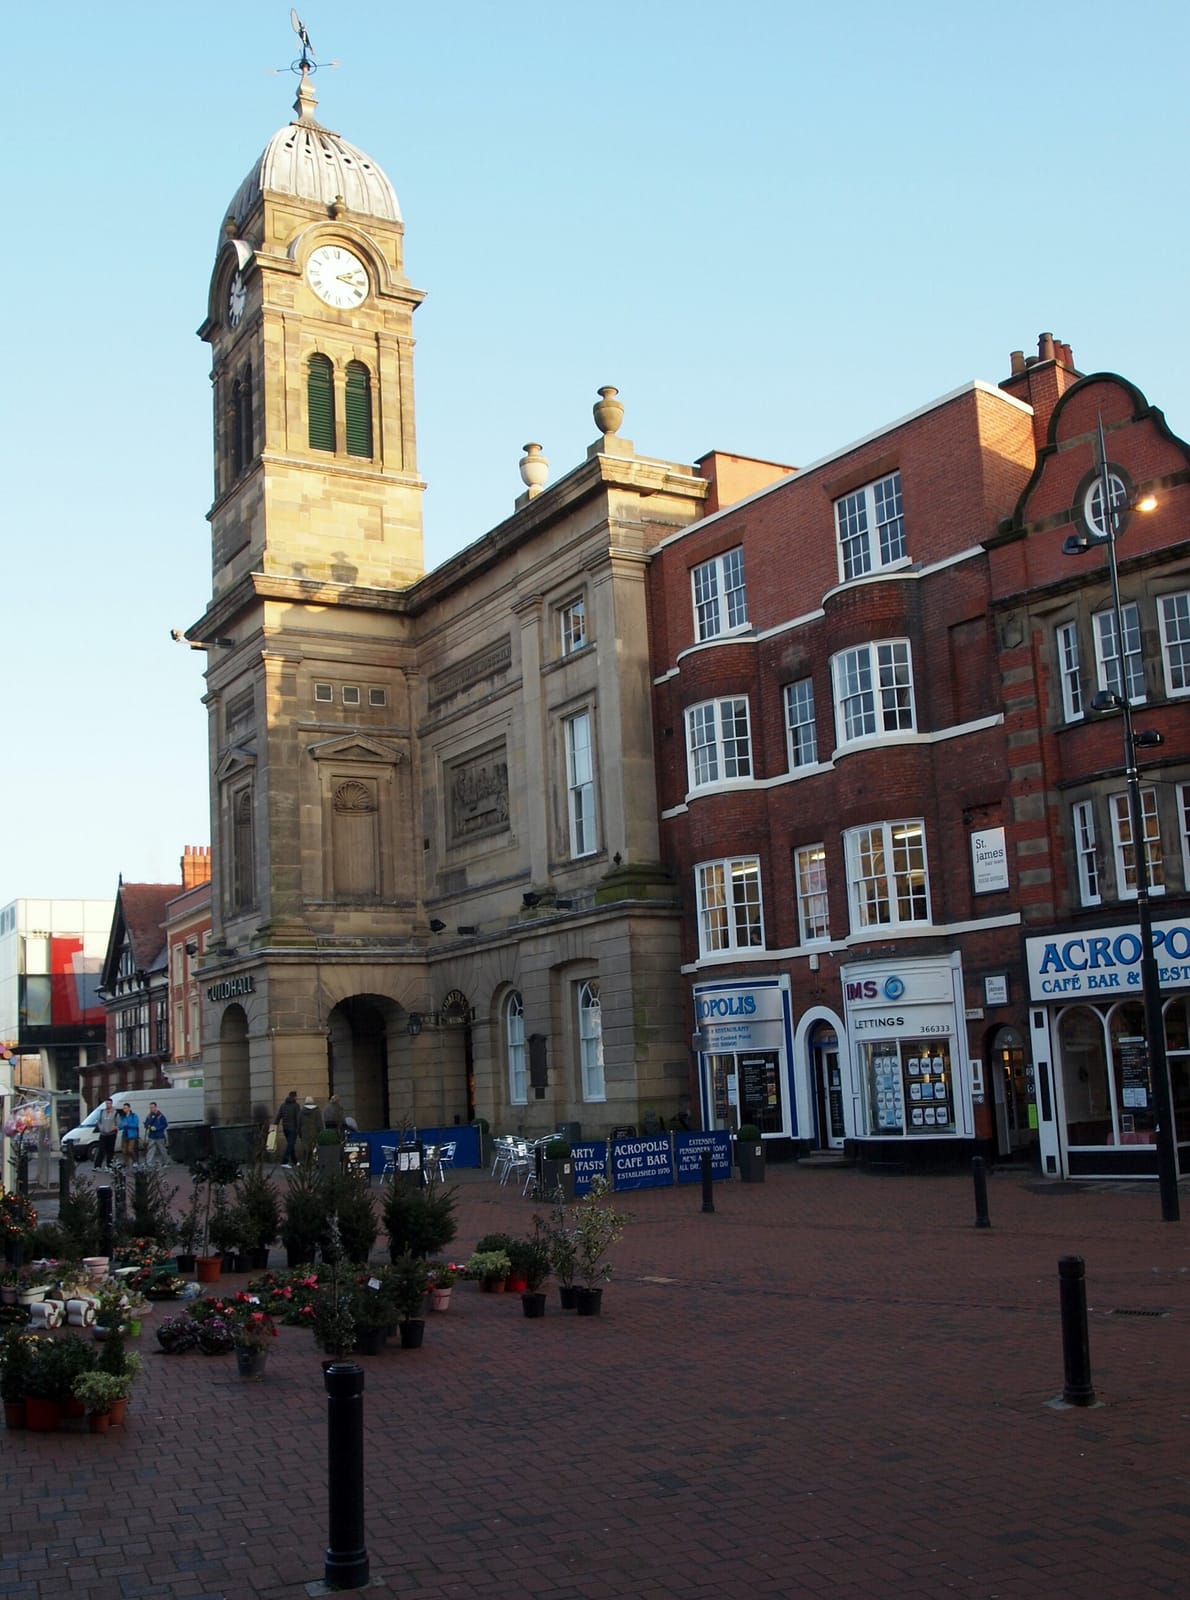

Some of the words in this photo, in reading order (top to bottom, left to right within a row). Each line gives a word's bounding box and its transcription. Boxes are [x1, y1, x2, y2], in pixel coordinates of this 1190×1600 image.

[976, 849, 1004, 863] james
[1042, 974, 1082, 993] CAFÉ
[1088, 973, 1120, 989] BAR
[1127, 971, 1140, 985] &
[1158, 966, 1190, 982] EST
[207, 976, 252, 1001] GUILDHALL
[855, 1016, 904, 1029] LETTINGS
[570, 1148, 595, 1158] ARTY
[614, 1140, 669, 1156] ACROPOLIS
[617, 1157, 644, 1169] CAFE
[647, 1154, 668, 1166] BAR
[617, 1169, 657, 1180] ESTABLISHED
